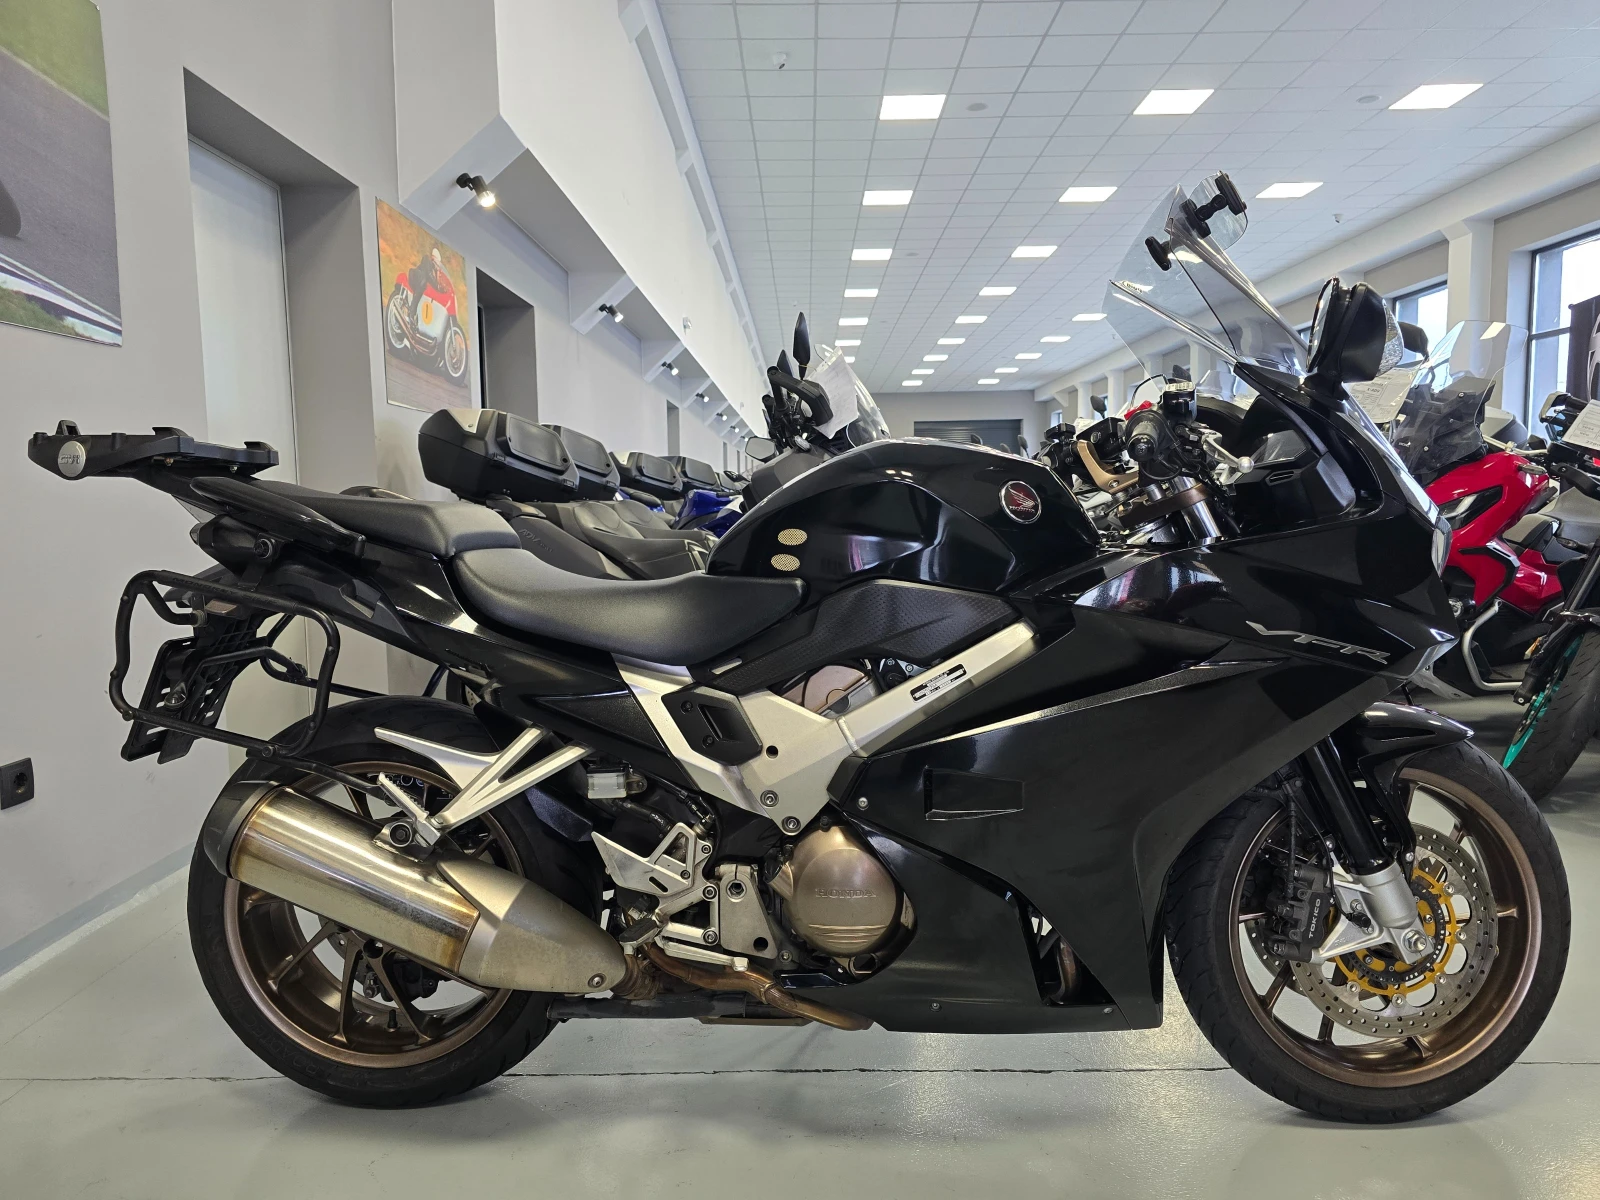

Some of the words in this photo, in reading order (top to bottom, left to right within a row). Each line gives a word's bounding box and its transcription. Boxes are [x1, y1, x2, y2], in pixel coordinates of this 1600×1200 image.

[1246, 620, 1391, 664] VFR
[815, 888, 877, 899] HONDA
[1308, 898, 1321, 939] TOKICO
